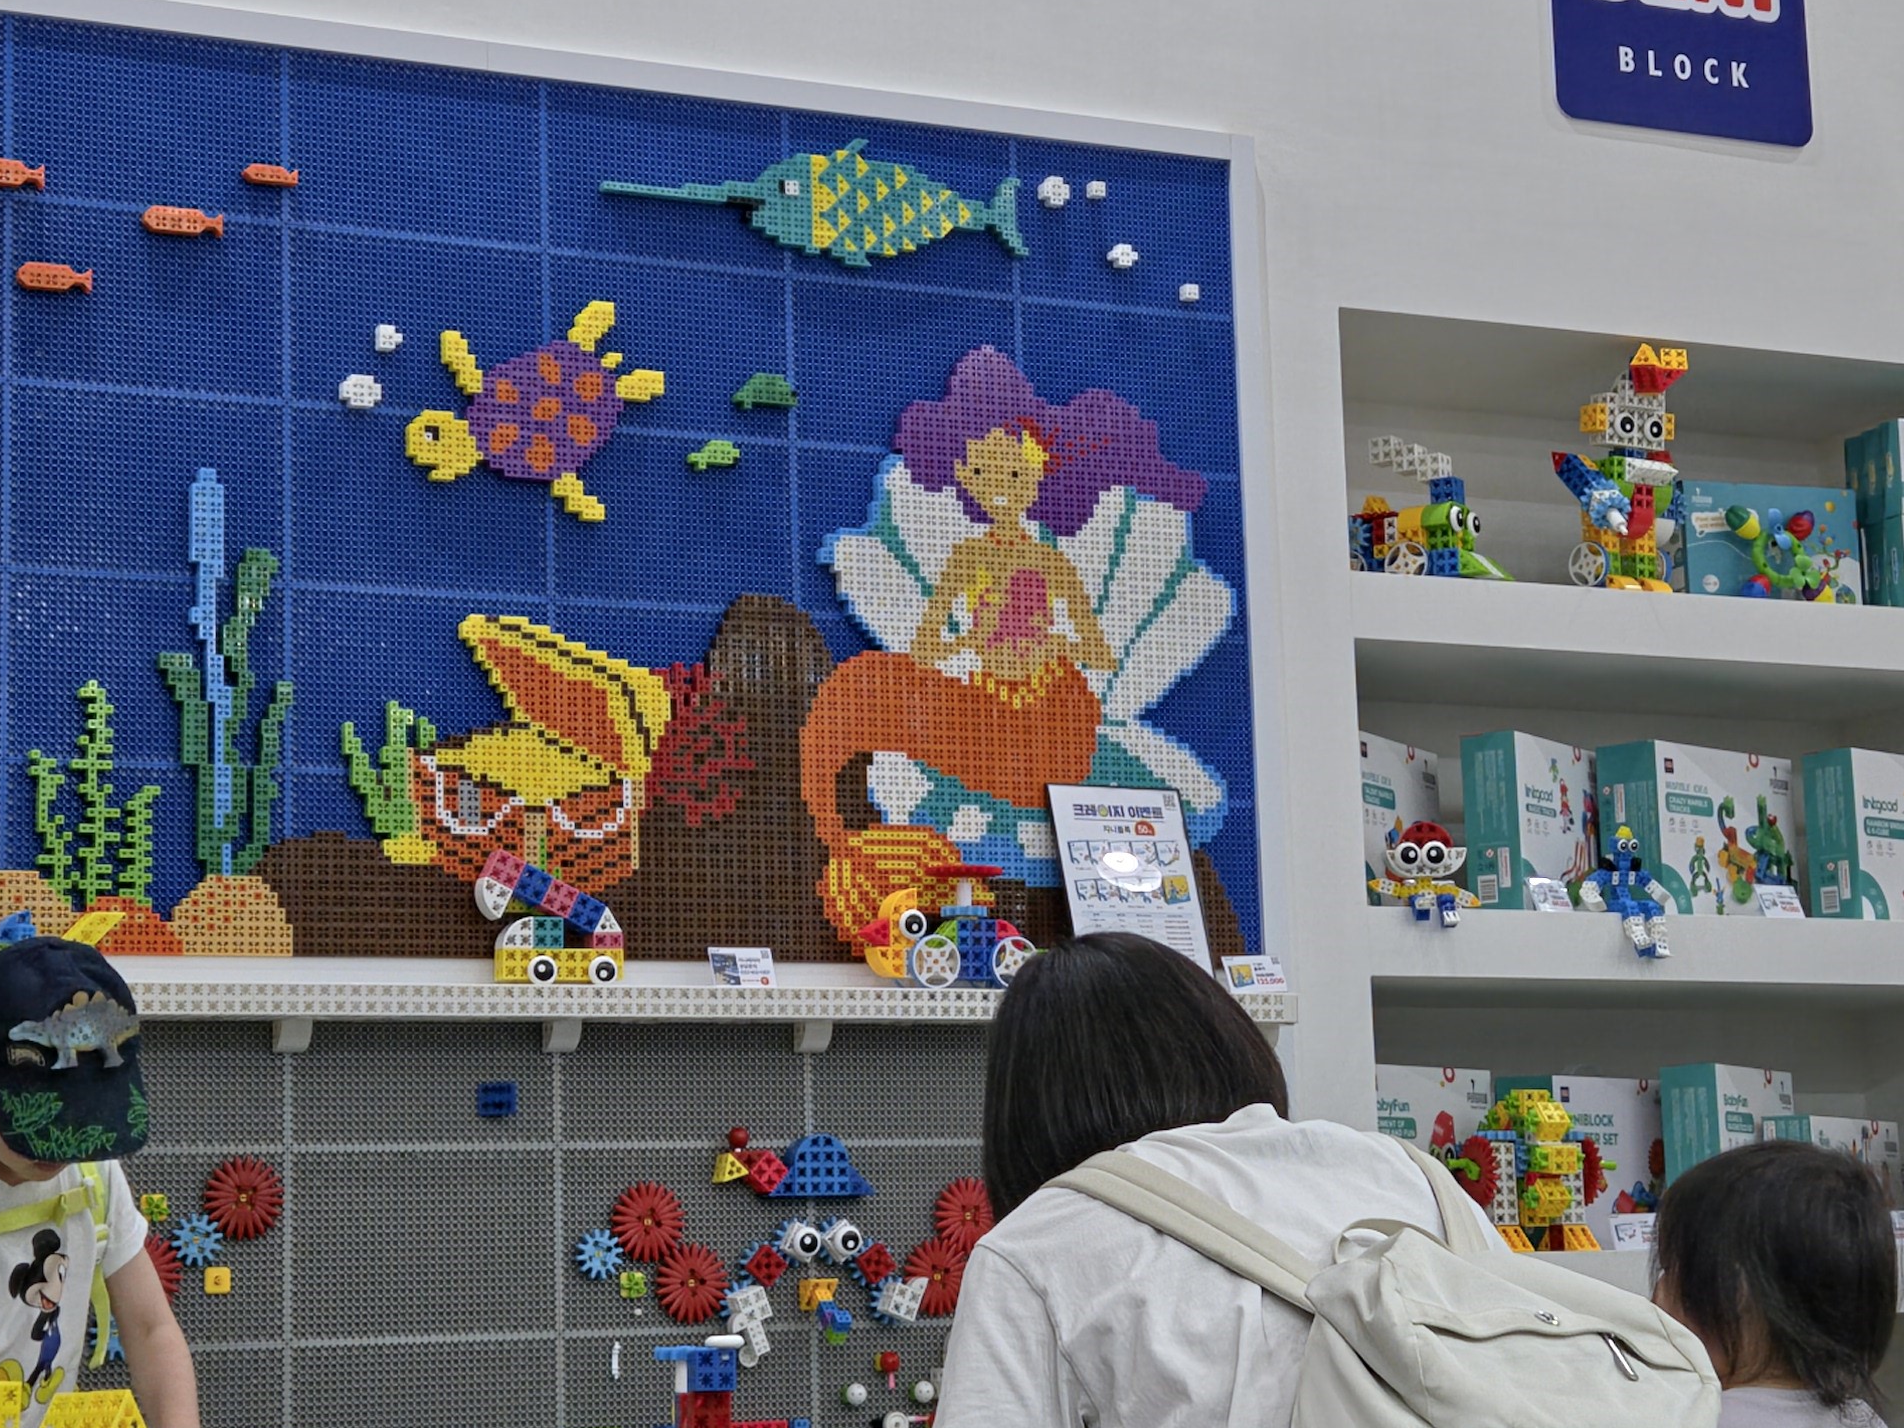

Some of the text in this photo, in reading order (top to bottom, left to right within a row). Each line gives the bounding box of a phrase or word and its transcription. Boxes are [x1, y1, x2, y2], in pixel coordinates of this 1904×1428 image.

[1618, 45, 1750, 89] BLOCK
[1072, 803, 1164, 820] 크레이지 이벤트
[1377, 1097, 1410, 1115] abyFun
[1602, 1132, 1619, 1145] SET
